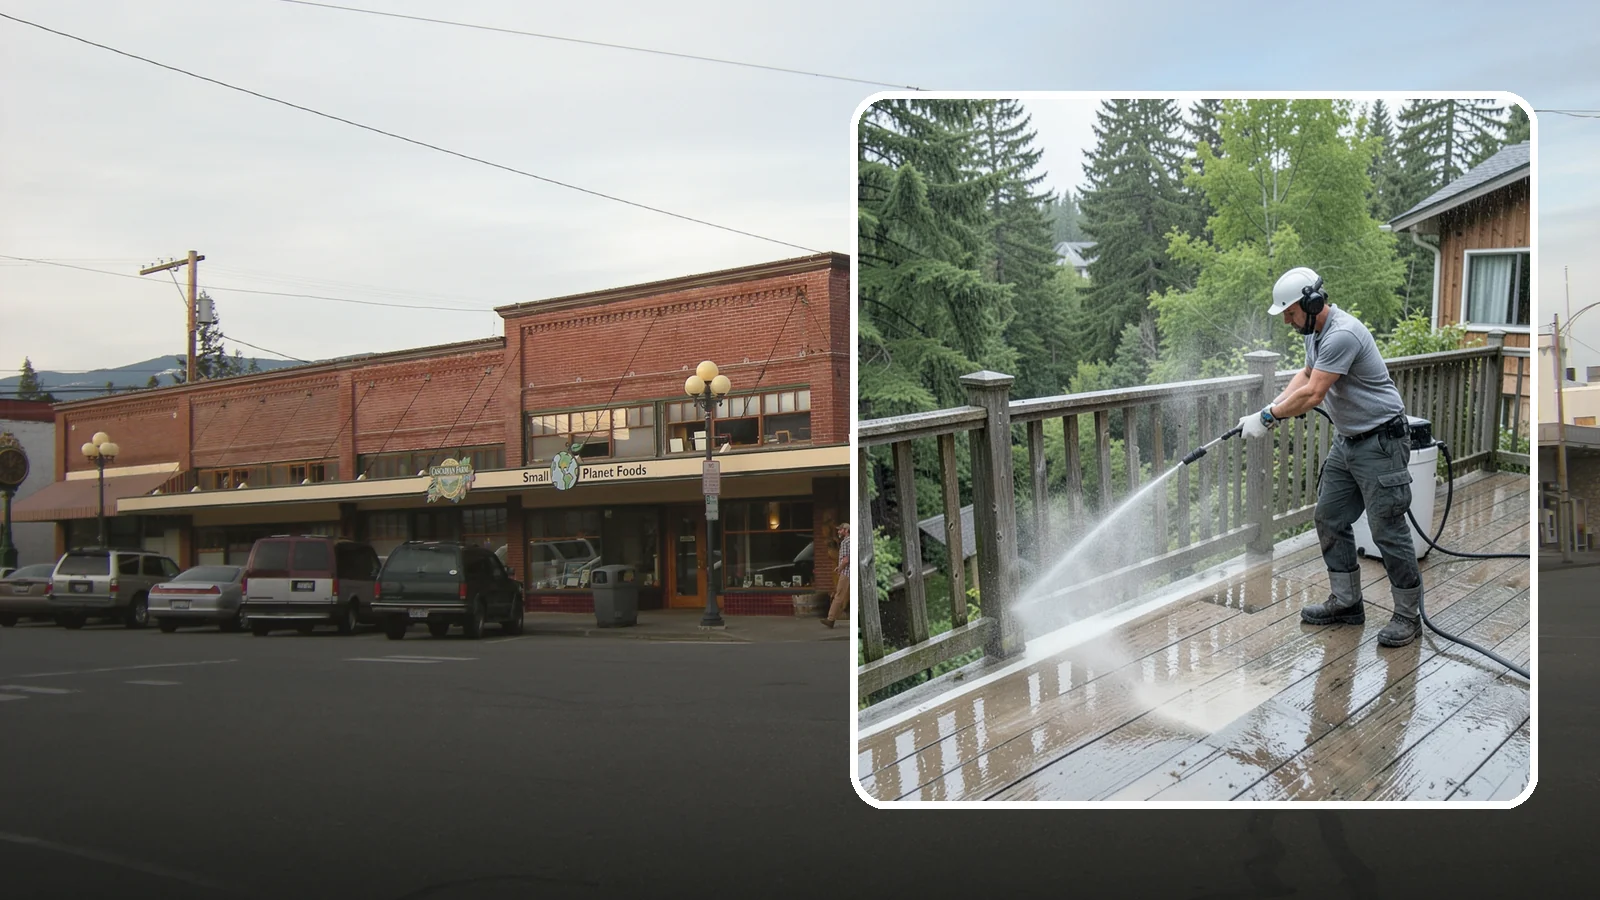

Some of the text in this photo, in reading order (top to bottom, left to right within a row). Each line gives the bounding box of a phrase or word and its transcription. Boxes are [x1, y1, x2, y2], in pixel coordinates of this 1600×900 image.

[456, 466, 469, 474] FARM
[523, 464, 647, 483] Small Planet Foods
